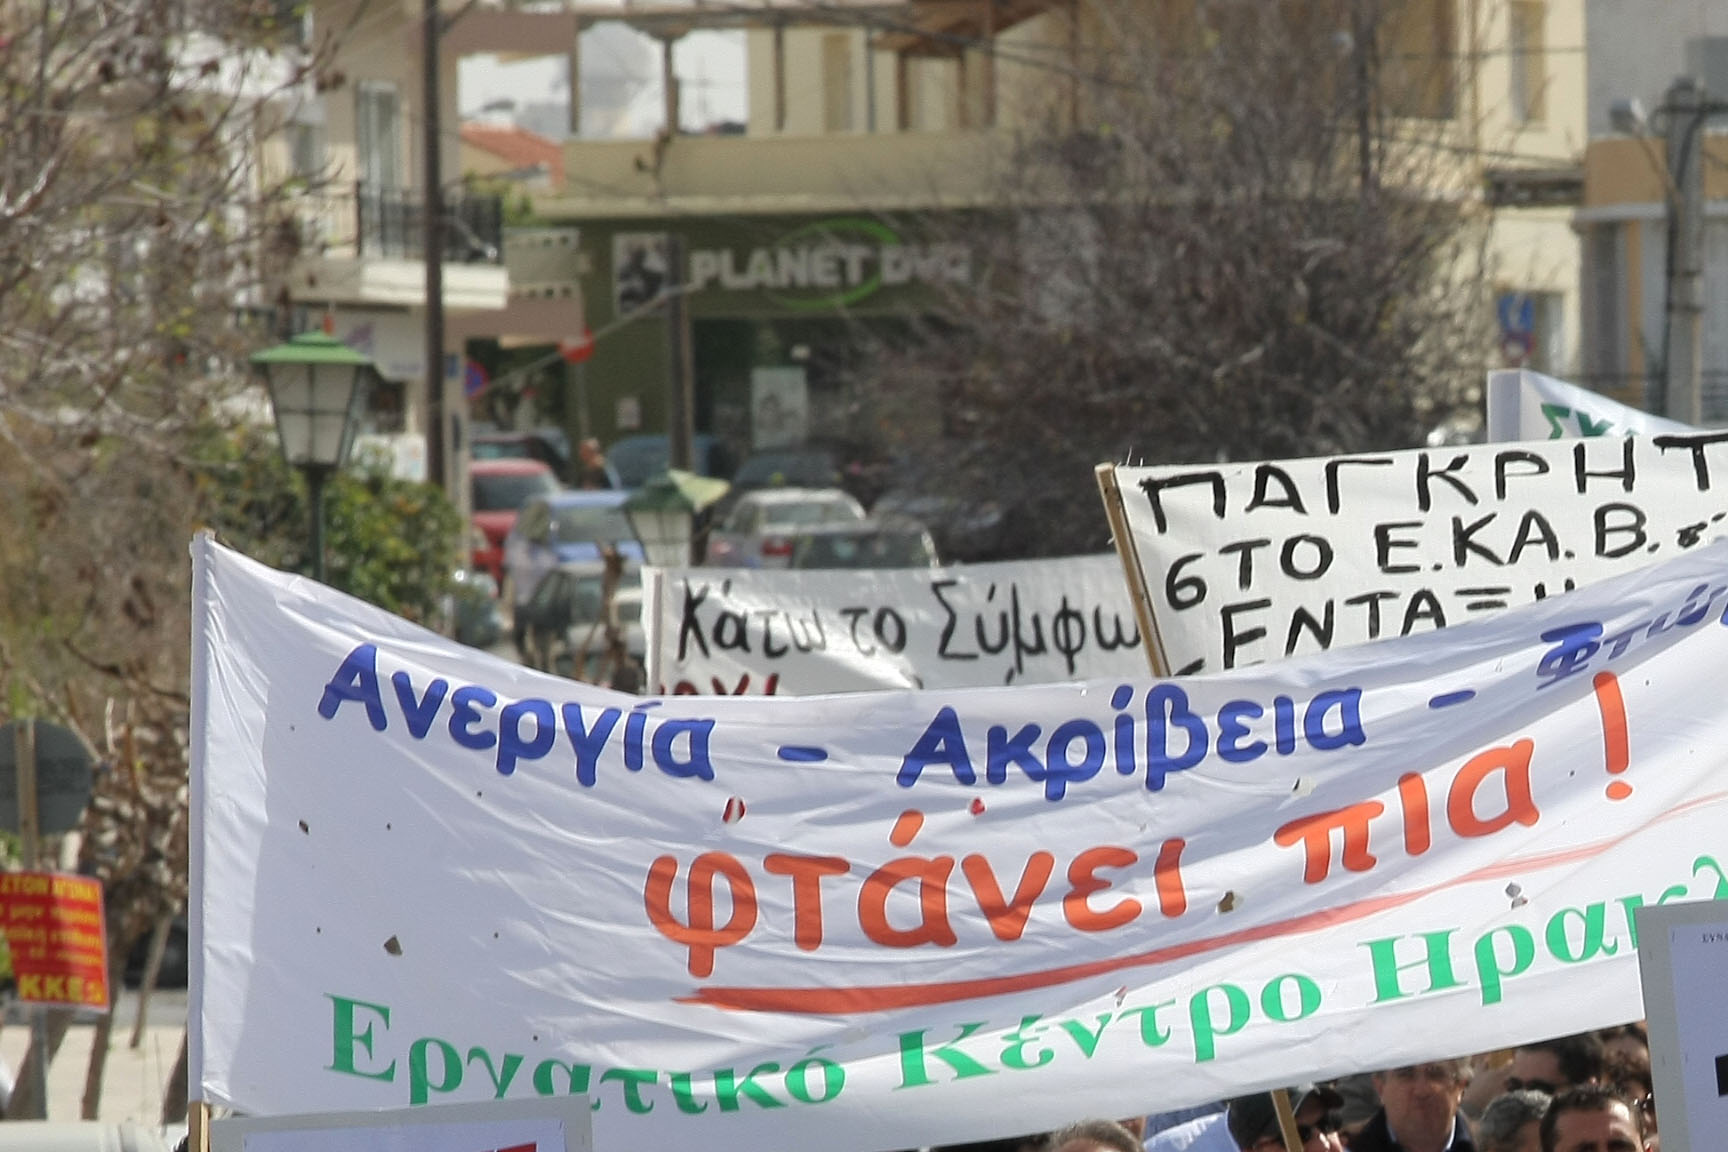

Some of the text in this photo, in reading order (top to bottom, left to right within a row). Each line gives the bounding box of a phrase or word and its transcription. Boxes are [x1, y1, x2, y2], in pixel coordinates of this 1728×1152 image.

[690, 245, 870, 288] PLANET
[678, 576, 826, 660] Κάτω
[840, 608, 907, 655] το
[1221, 578, 1576, 670] ΕΝΤΑΞ
[317, 643, 717, 786] Ανεργία
[897, 684, 1366, 801] Ακρίβεια
[643, 809, 1187, 978] φτάνει
[323, 992, 846, 1114] Εργατικό
[892, 970, 1321, 1091] Κέντρο
